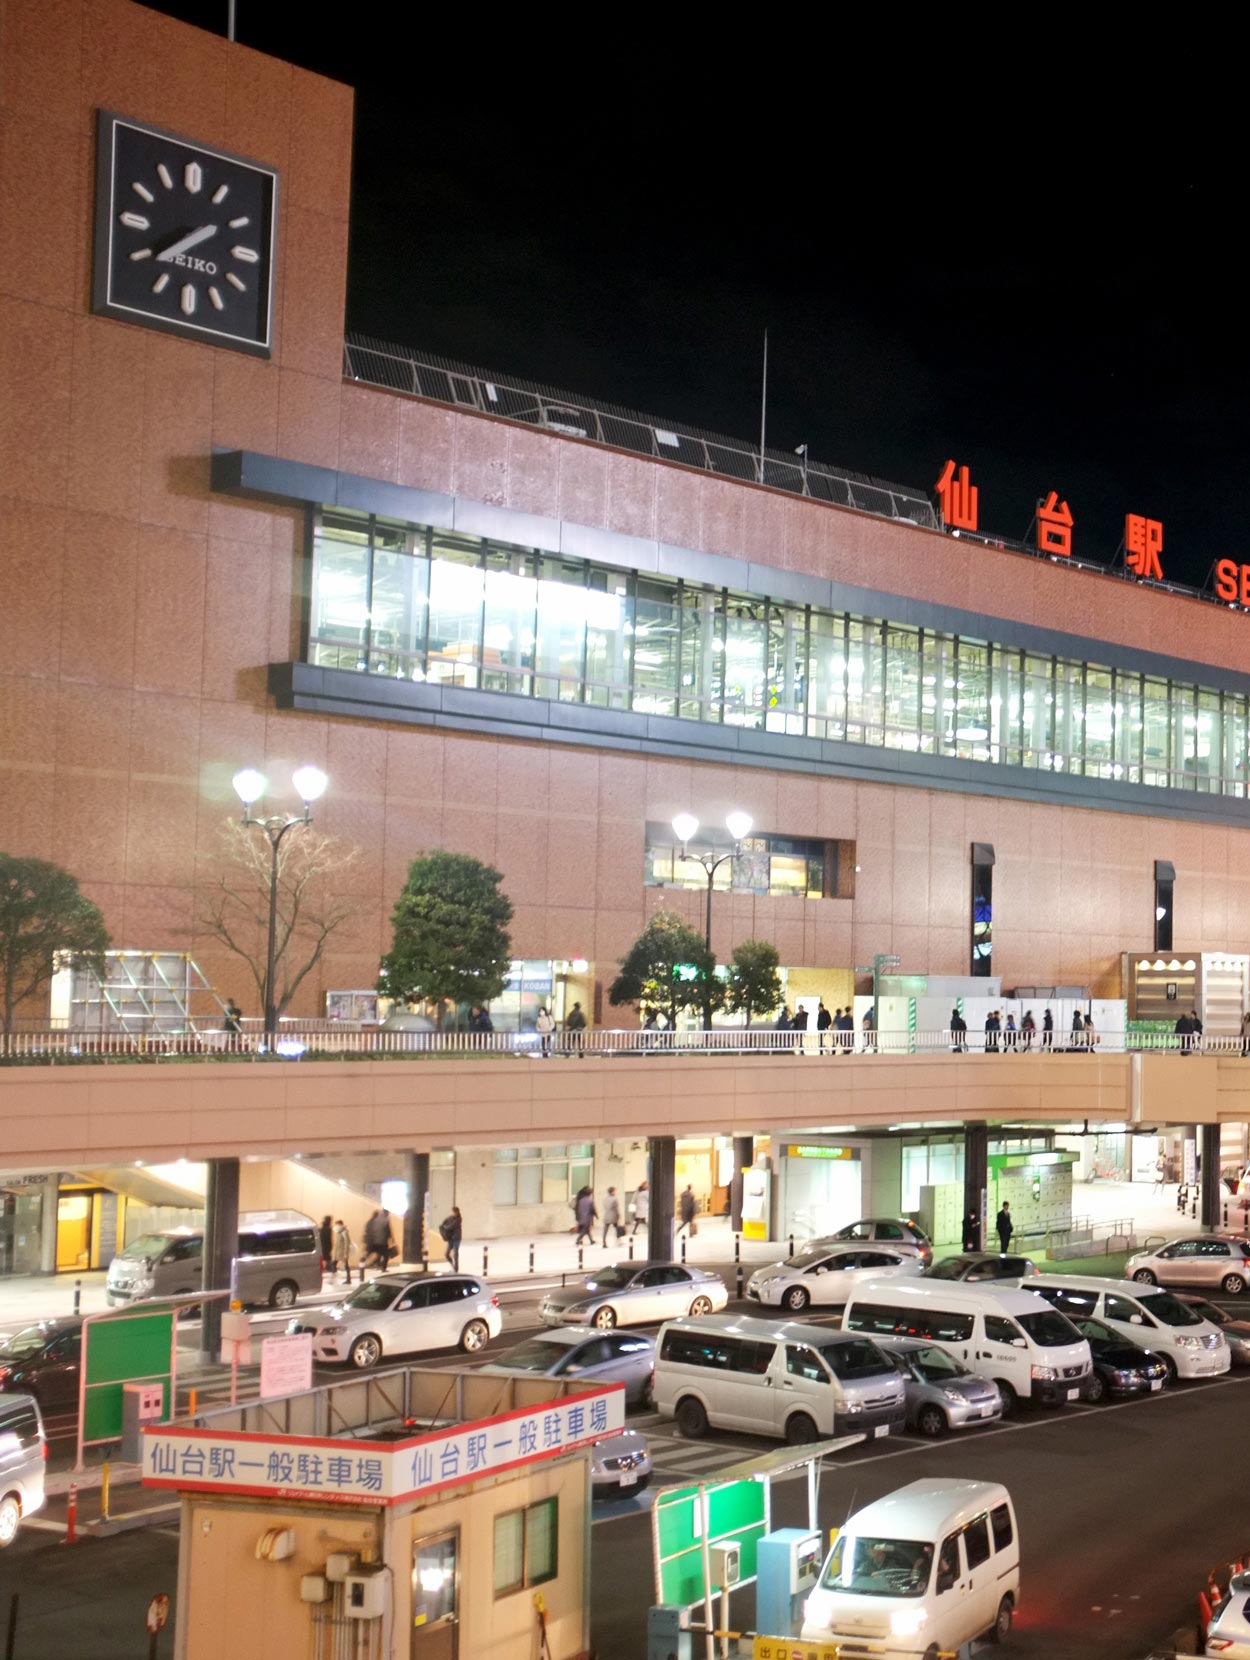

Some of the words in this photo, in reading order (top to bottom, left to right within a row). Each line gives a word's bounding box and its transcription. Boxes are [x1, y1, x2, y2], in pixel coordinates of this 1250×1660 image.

[935, 459, 1164, 580] 仙台駅
[150, 1442, 384, 1492] 仙台駅一般駐車場
[411, 1399, 608, 1488] 仙台駅一般駐車場
